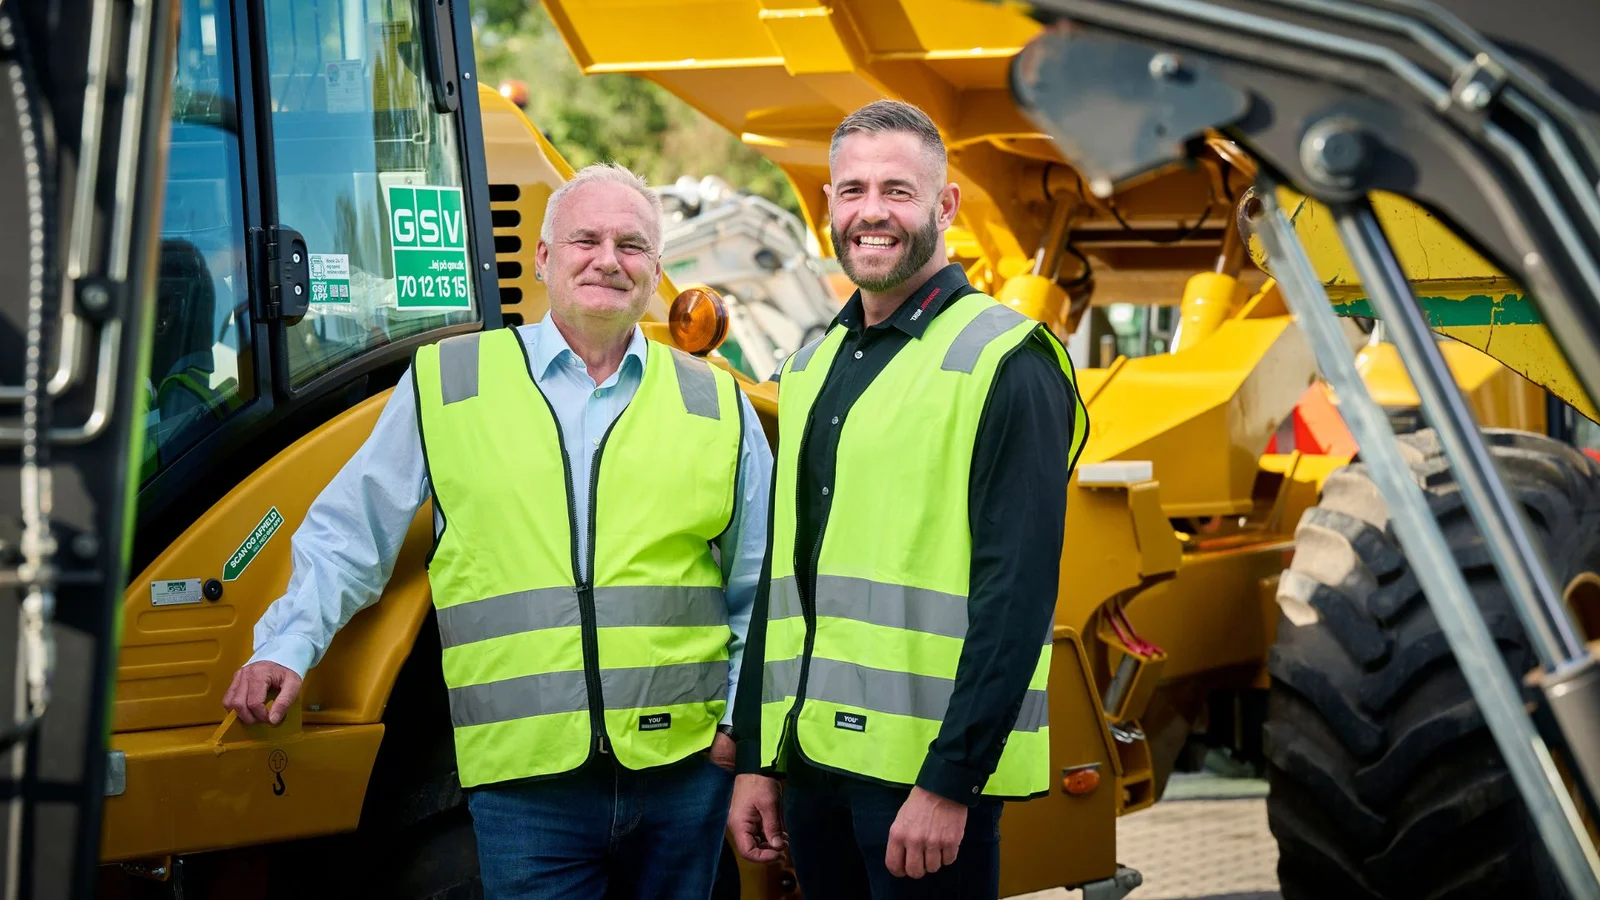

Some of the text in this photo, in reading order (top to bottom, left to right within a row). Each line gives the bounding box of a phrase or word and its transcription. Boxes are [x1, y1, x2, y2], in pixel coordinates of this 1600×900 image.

[394, 208, 460, 243] GSV
[312, 284, 327, 293] GSV
[313, 292, 328, 301] APP
[398, 276, 467, 298] 70 12 13 15
[230, 547, 248, 568] SCAN
[246, 537, 256, 549] OG
[255, 511, 277, 540] AFMELD
